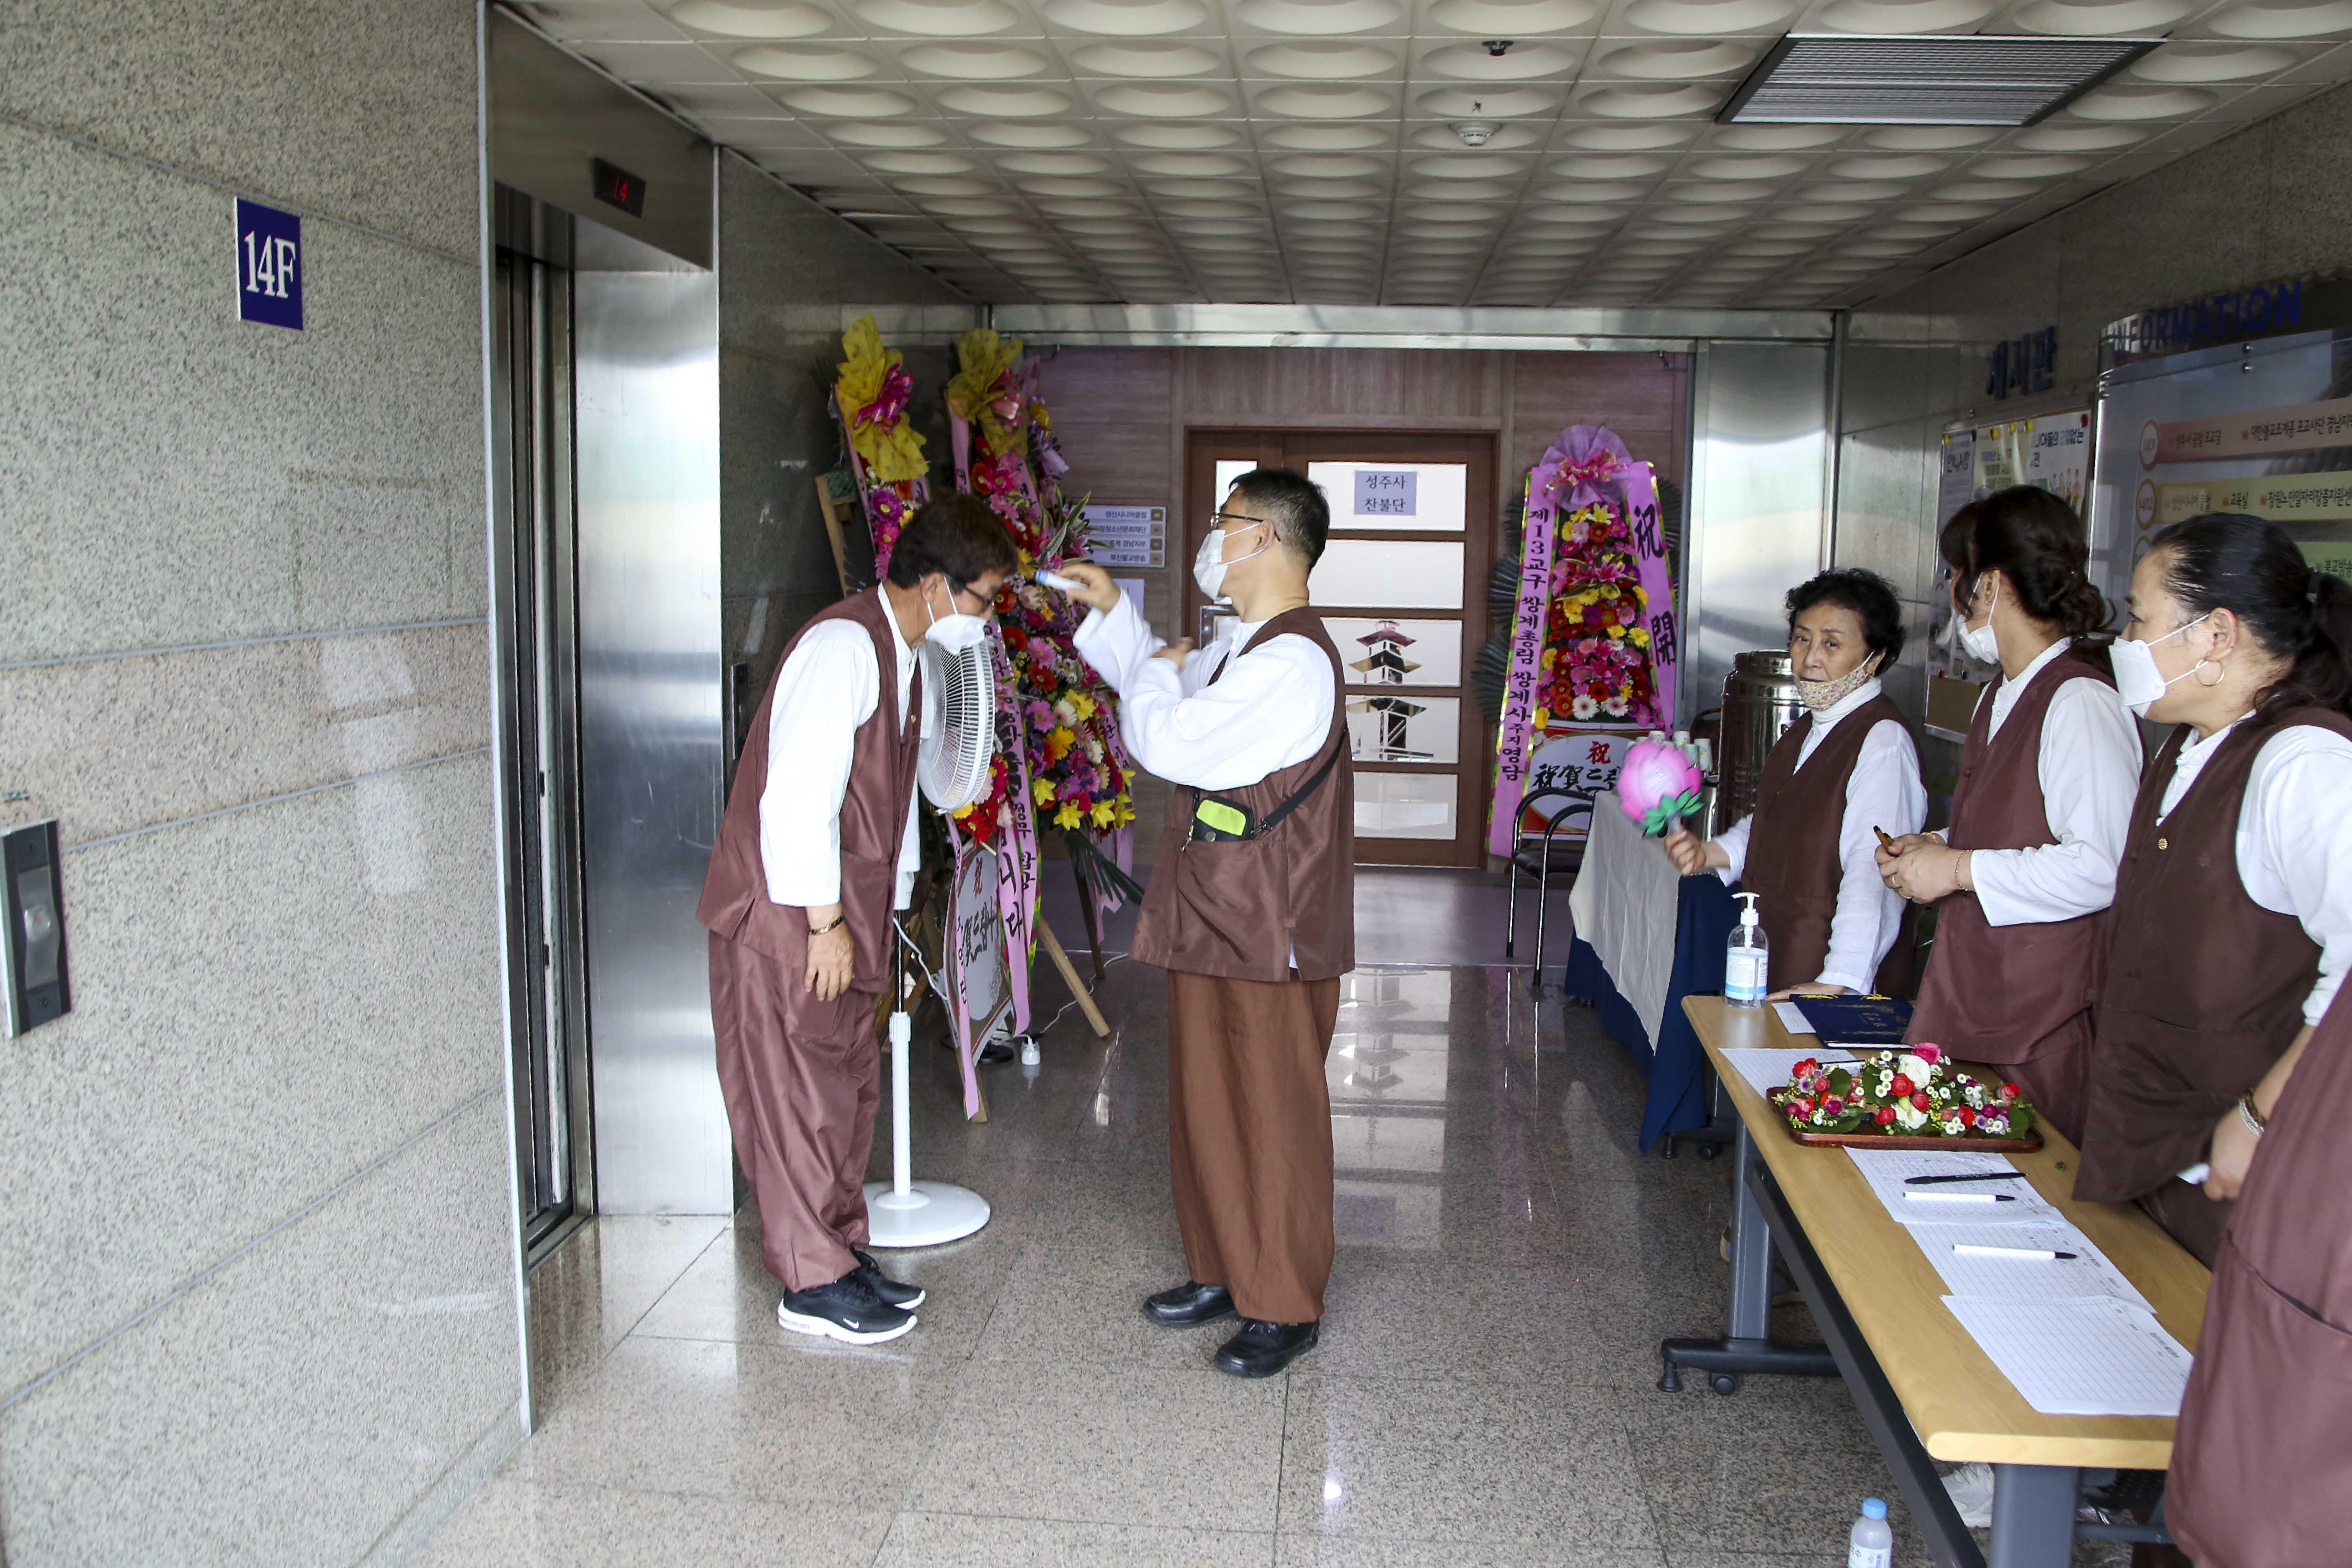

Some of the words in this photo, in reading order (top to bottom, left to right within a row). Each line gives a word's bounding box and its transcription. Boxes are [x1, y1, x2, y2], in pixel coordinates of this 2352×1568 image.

[245, 230, 296, 298] 14F
[1985, 325, 2057, 400] 게시판
[1364, 497, 1406, 512] 찬불단
[1366, 475, 1406, 490] 성주사
[1523, 508, 1549, 589] 제13교구
[1516, 596, 1545, 665] 쌍계총림
[1586, 740, 1612, 765] 祝
